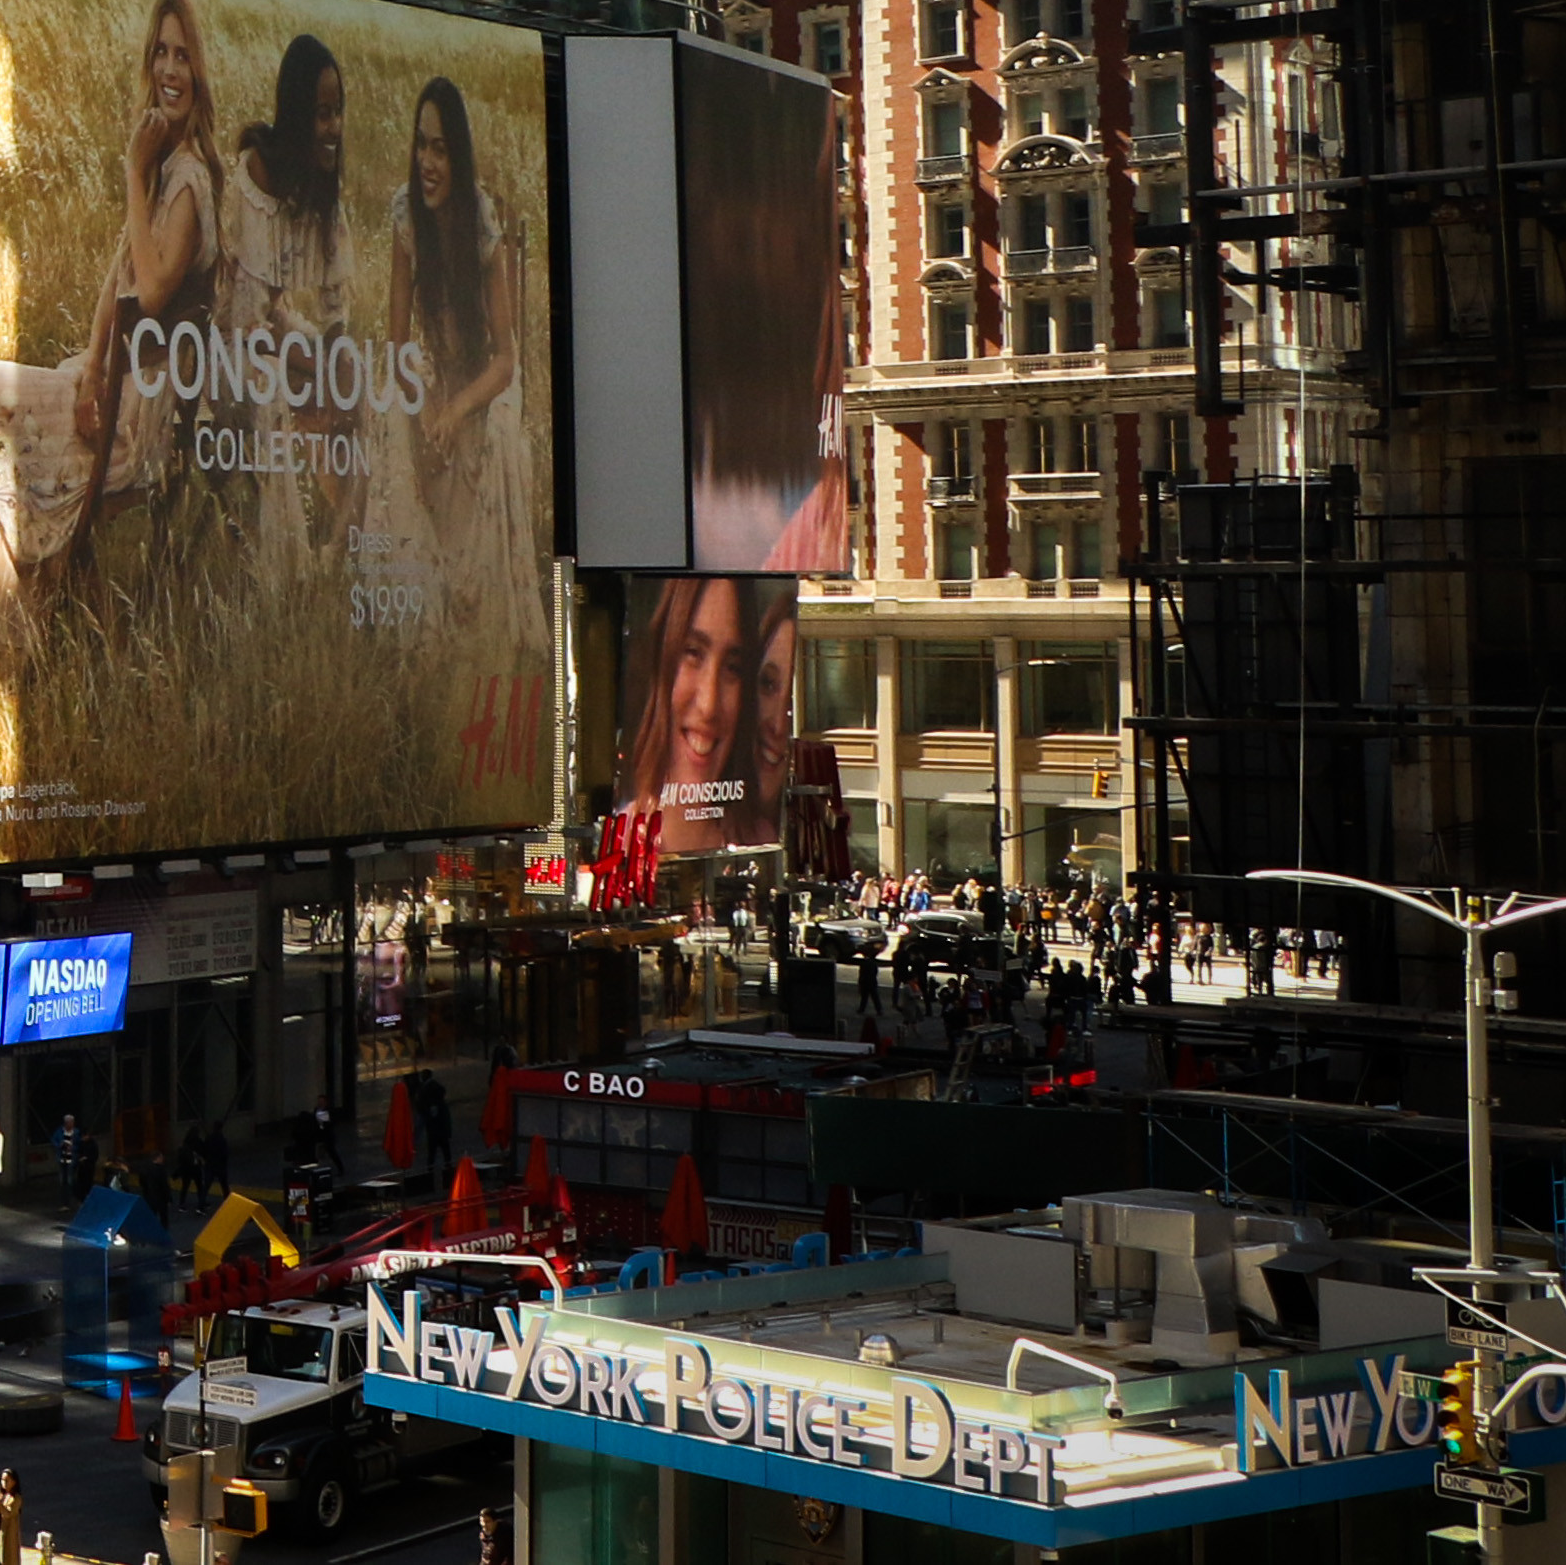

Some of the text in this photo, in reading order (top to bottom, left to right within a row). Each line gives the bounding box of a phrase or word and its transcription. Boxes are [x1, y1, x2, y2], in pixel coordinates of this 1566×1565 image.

[130, 317, 425, 415] CONSCIOUS
[195, 426, 371, 477] COLLECTION
[348, 525, 393, 553] Dress
[458, 674, 543, 791] H&M
[678, 780, 744, 805] CONSCIOUS
[6, 805, 33, 822] Nuru
[37, 803, 58, 820] and
[61, 801, 101, 818] Rosario
[104, 799, 147, 816] Dawson
[685, 806, 724, 821] COLLECTION
[28, 958, 107, 998] NASDAQ
[25, 990, 106, 1026] OPENING BELL
[563, 1071, 645, 1098] C BAO
[710, 1224, 775, 1259] TACOS
[1450, 1329, 1506, 1349] BIKE LANE
[1443, 1474, 1517, 1499] ONE WAY
